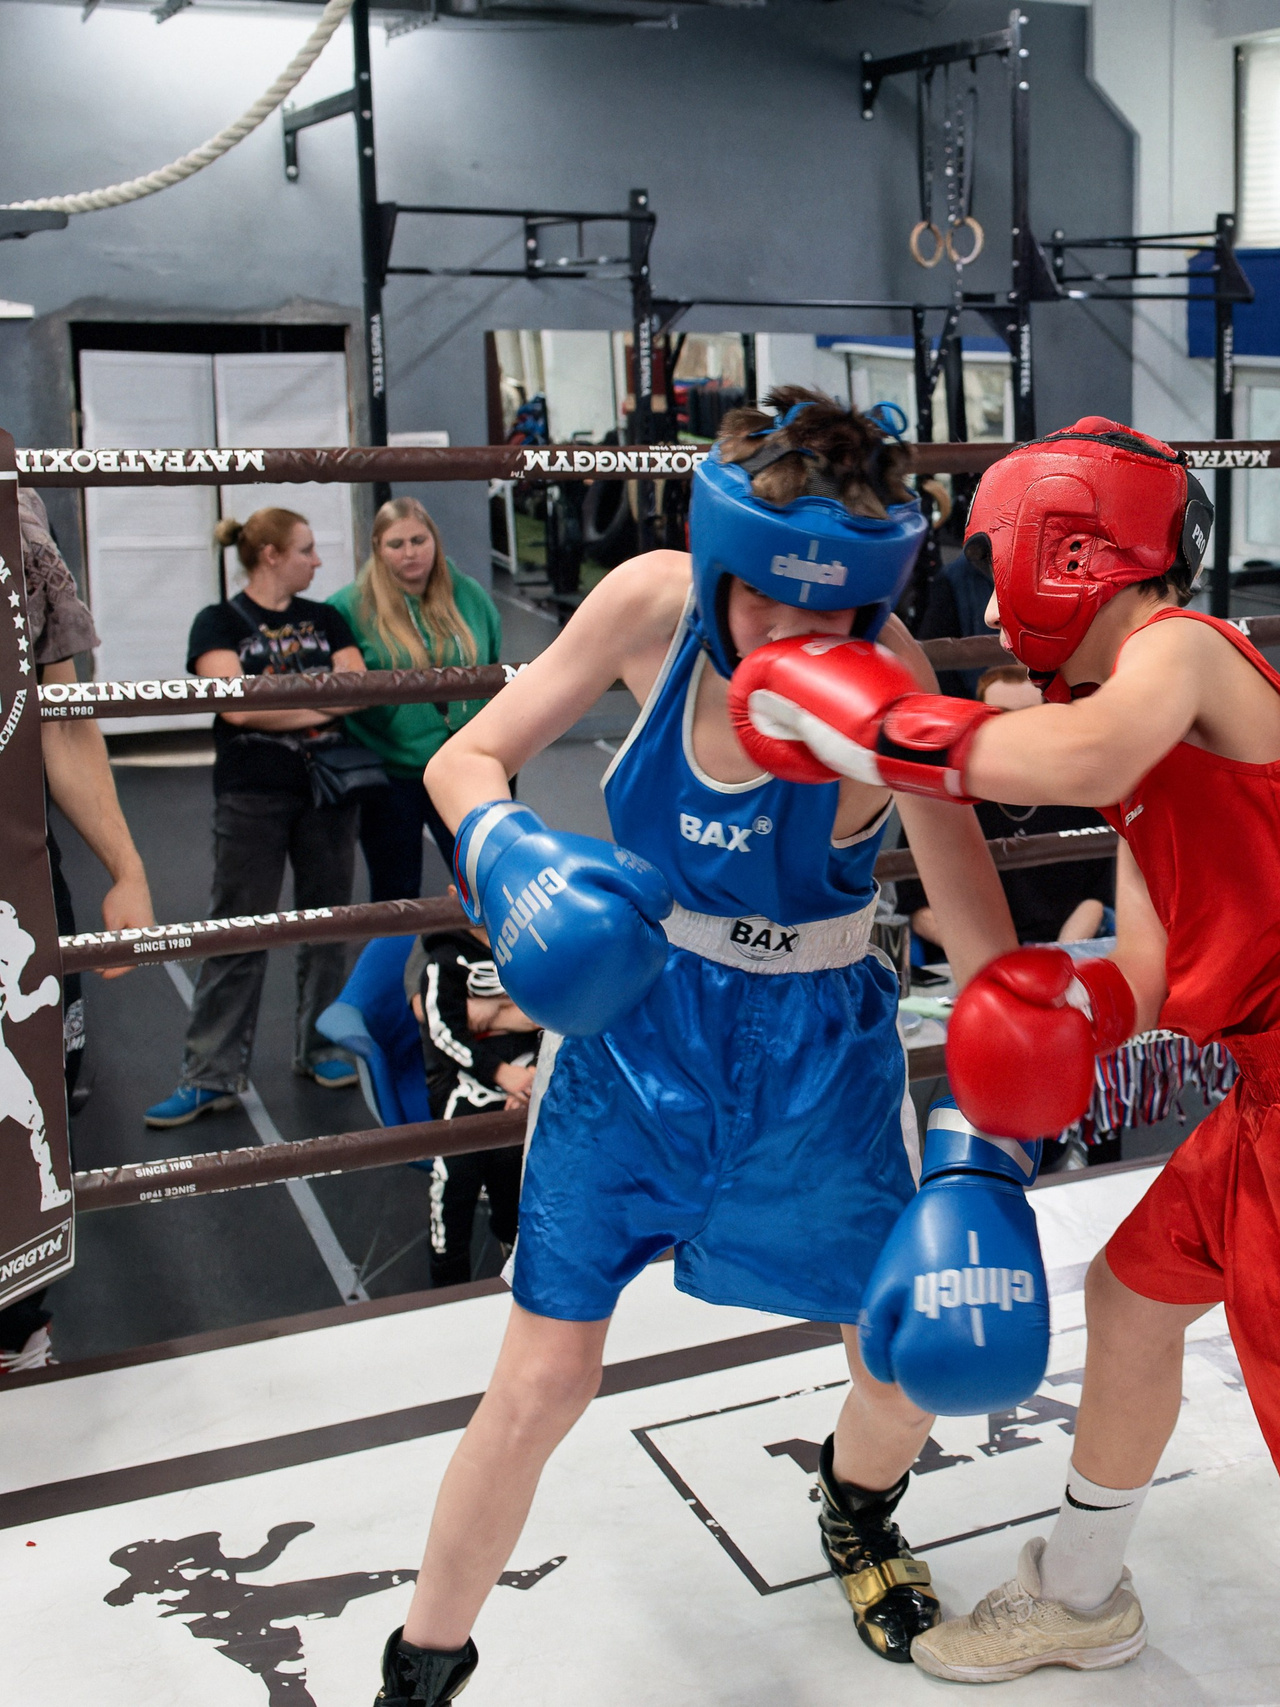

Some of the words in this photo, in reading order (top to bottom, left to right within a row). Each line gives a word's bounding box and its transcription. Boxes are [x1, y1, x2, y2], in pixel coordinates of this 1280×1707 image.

[70, 706, 94, 716] 1980
[495, 866, 567, 968] clinch
[133, 940, 166, 953] SINCE
[168, 937, 192, 949] 1980
[730, 920, 800, 953] BAX
[135, 1165, 168, 1178] SINCE
[169, 1160, 193, 1172] 1980
[164, 1184, 197, 1196] SINCE
[914, 1267, 1035, 1320] clinch
